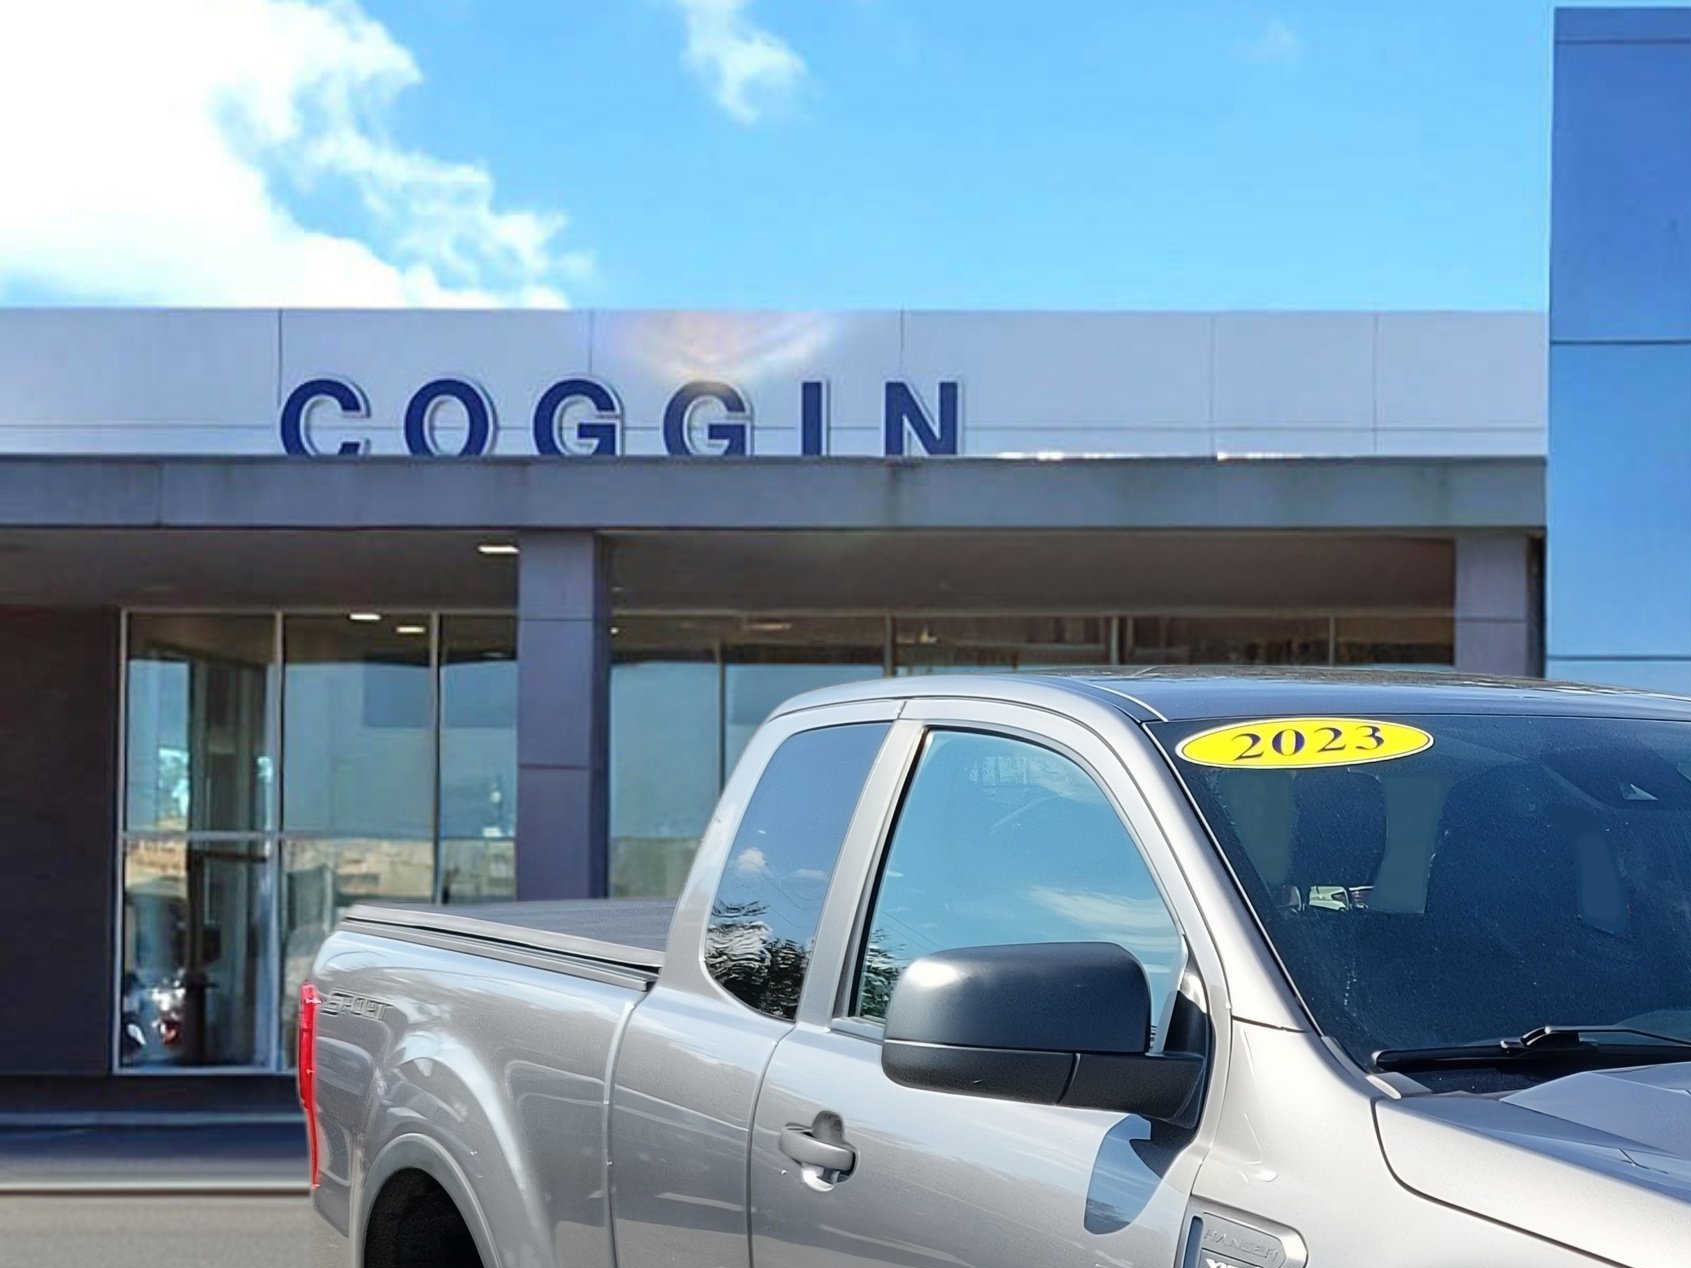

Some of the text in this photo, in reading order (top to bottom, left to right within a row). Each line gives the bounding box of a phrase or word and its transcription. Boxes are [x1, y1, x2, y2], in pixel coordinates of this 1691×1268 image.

[279, 378, 960, 457] COGGIN
[1231, 725, 1385, 762] 2023
[320, 990, 394, 1021] SPORT
